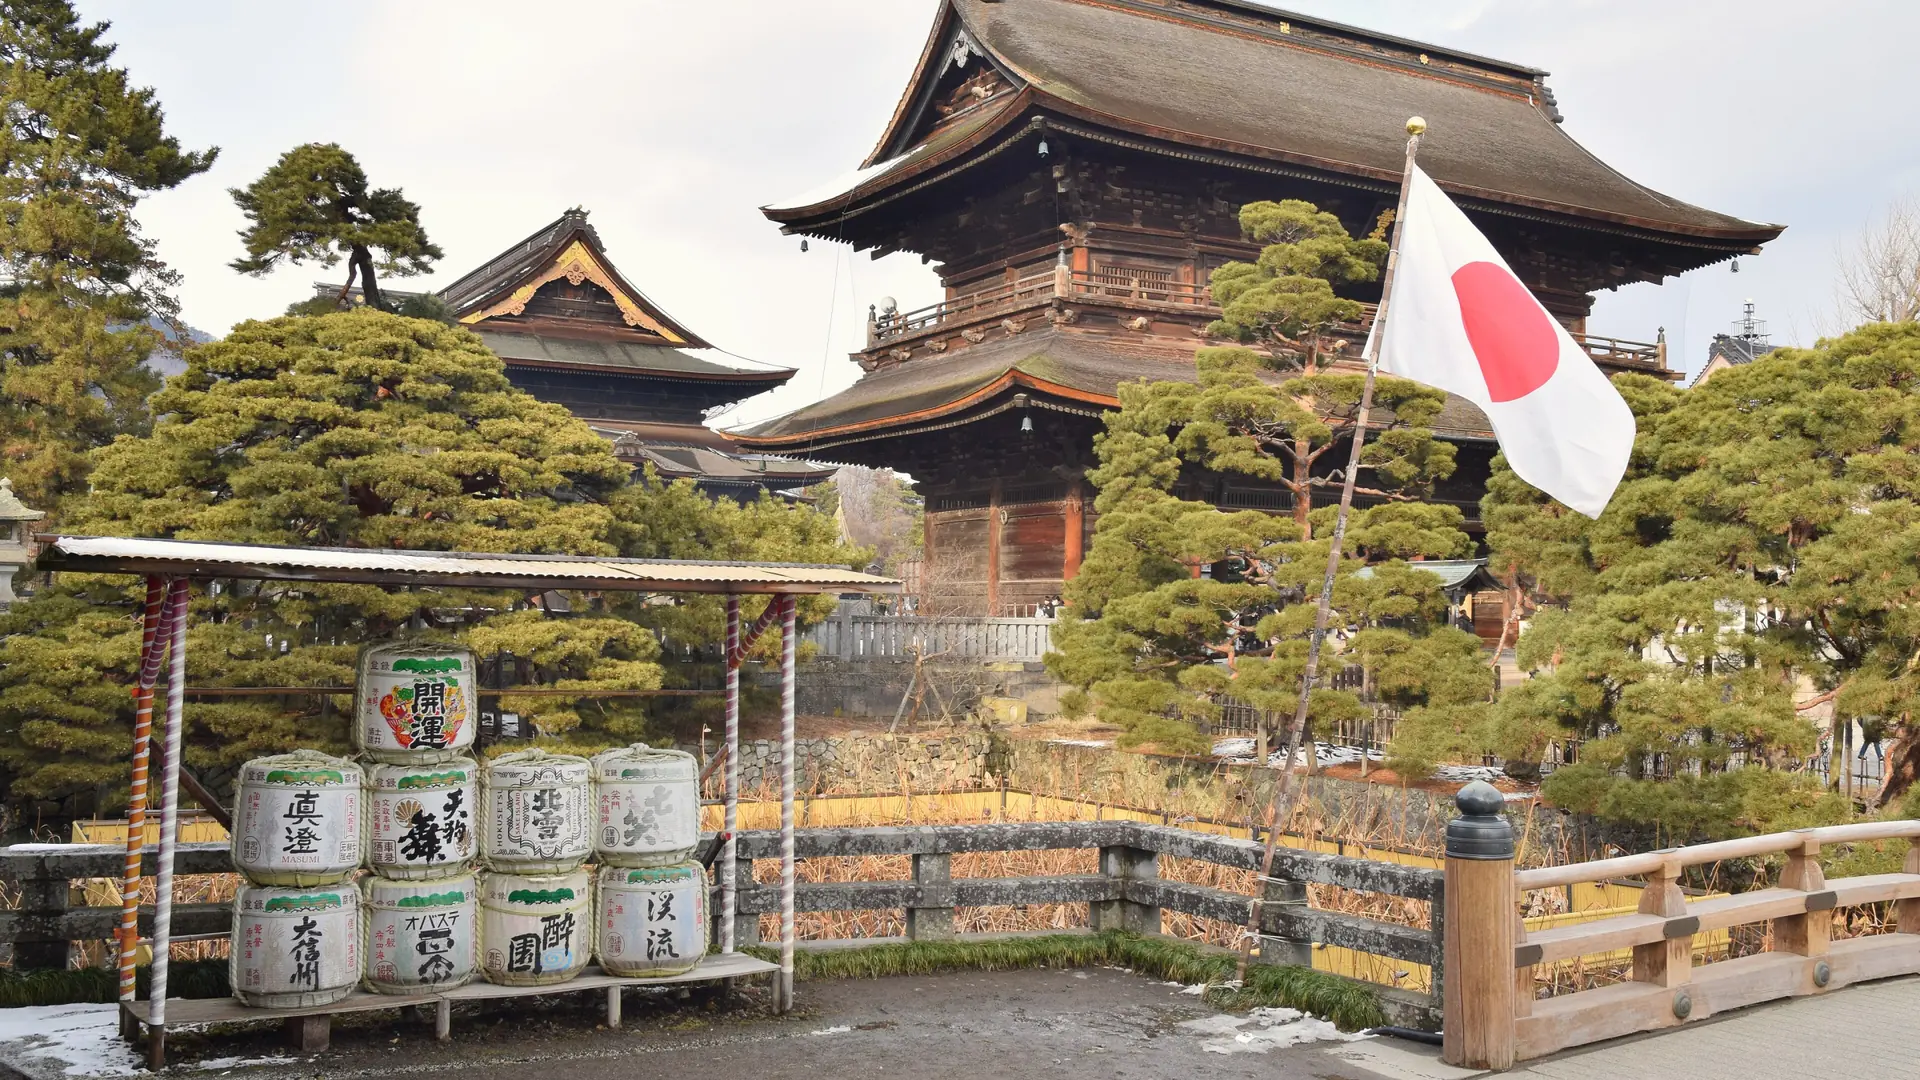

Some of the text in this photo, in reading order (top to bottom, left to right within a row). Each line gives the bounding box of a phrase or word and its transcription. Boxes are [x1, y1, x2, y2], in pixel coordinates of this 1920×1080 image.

[410, 682, 448, 750] 開運
[532, 789, 564, 839] 北雪
[288, 916, 322, 992] 大信州
[405, 911, 460, 930] オバステ
[646, 890, 680, 960] 渓流
